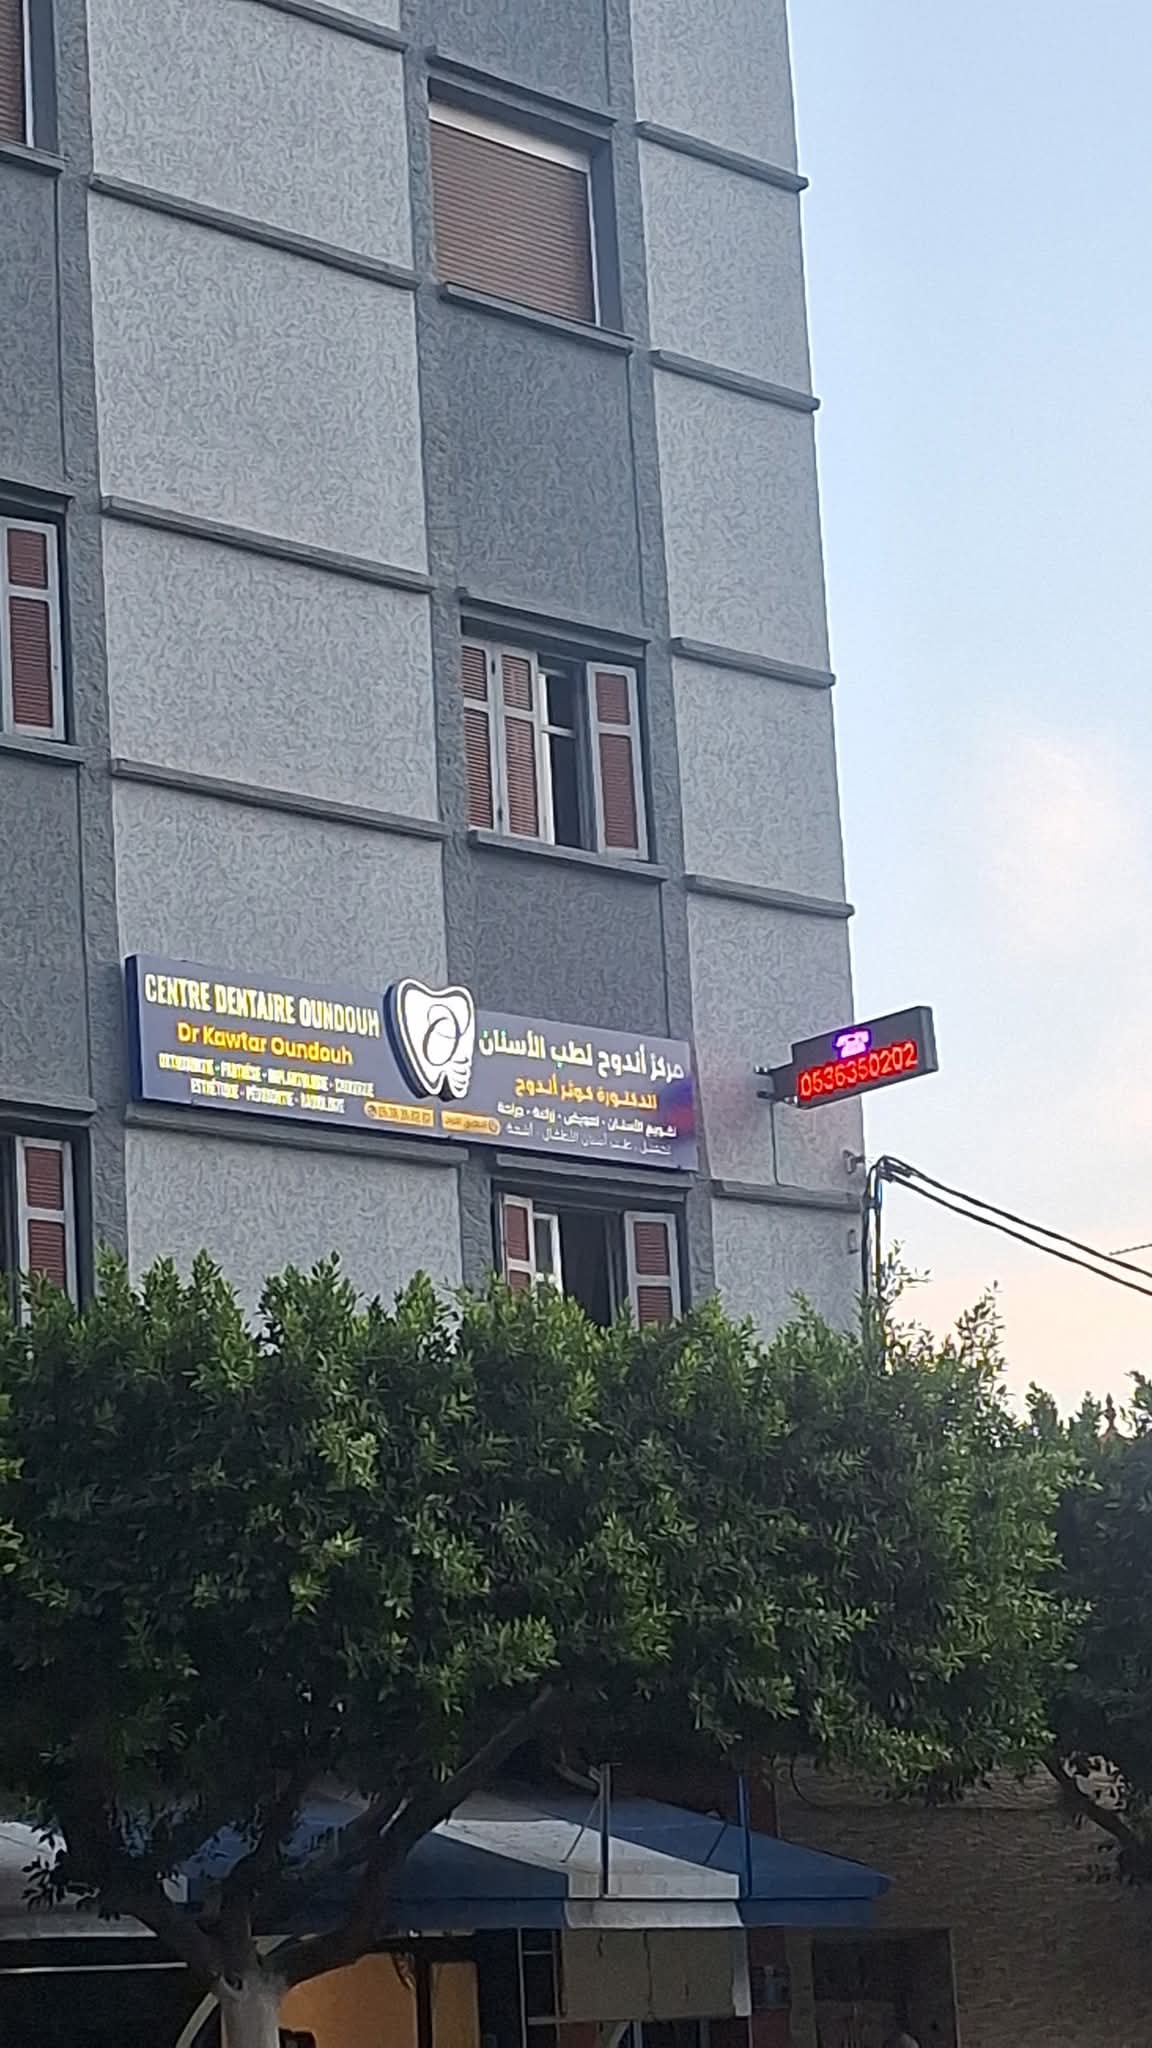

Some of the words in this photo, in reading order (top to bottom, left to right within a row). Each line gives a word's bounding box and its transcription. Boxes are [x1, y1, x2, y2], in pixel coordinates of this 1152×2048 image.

[144, 973, 212, 1012] CENTRE
[214, 984, 296, 1025] DENTAIRE
[298, 997, 381, 1038] OUNDOUH
[177, 1022, 199, 1044] Dr
[202, 1024, 267, 1053] Kawtar
[270, 1036, 353, 1065] Oundouh
[478, 1028, 546, 1061] الأسنان
[551, 1041, 593, 1069] لطب
[650, 1053, 685, 1084] مركز
[799, 1042, 919, 1097] 0536350202
